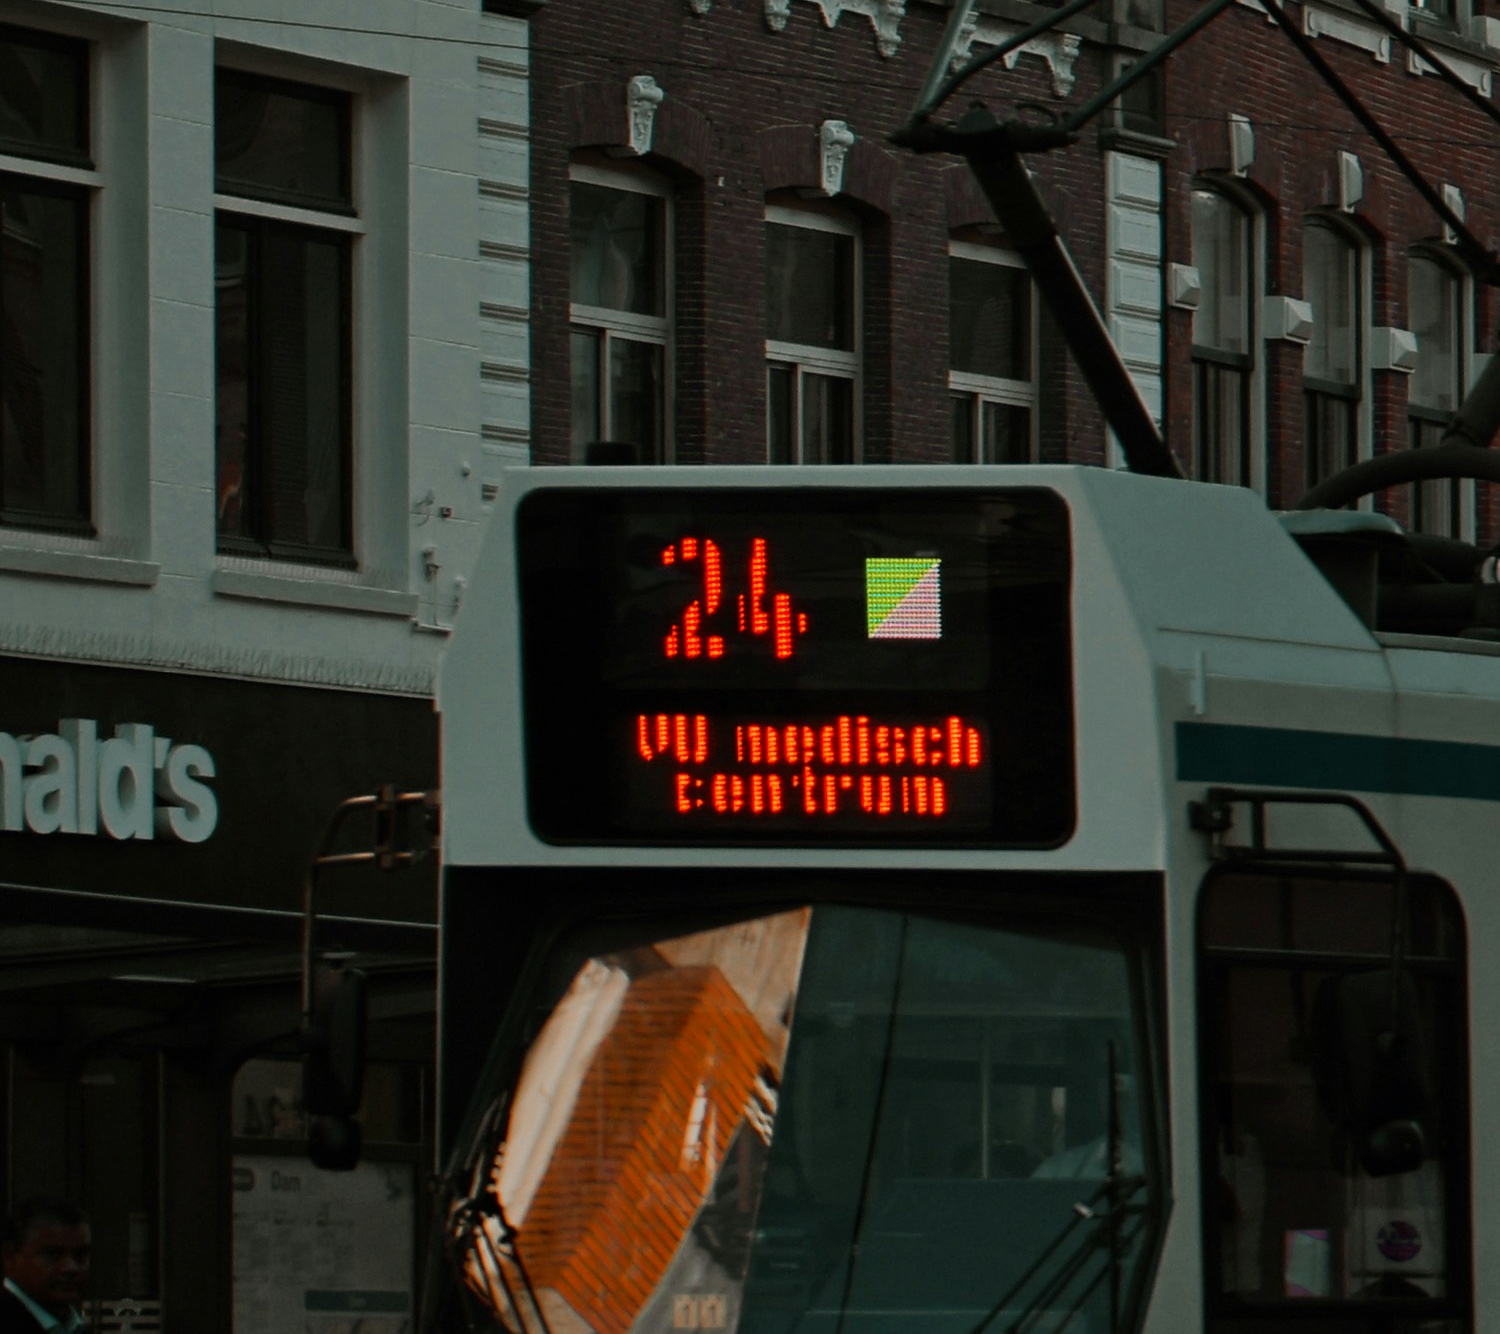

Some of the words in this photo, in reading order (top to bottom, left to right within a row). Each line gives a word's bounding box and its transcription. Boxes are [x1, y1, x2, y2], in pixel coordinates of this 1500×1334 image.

[662, 536, 808, 659] 24
[736, 714, 981, 768] medisch
[676, 765, 947, 816] centrum
